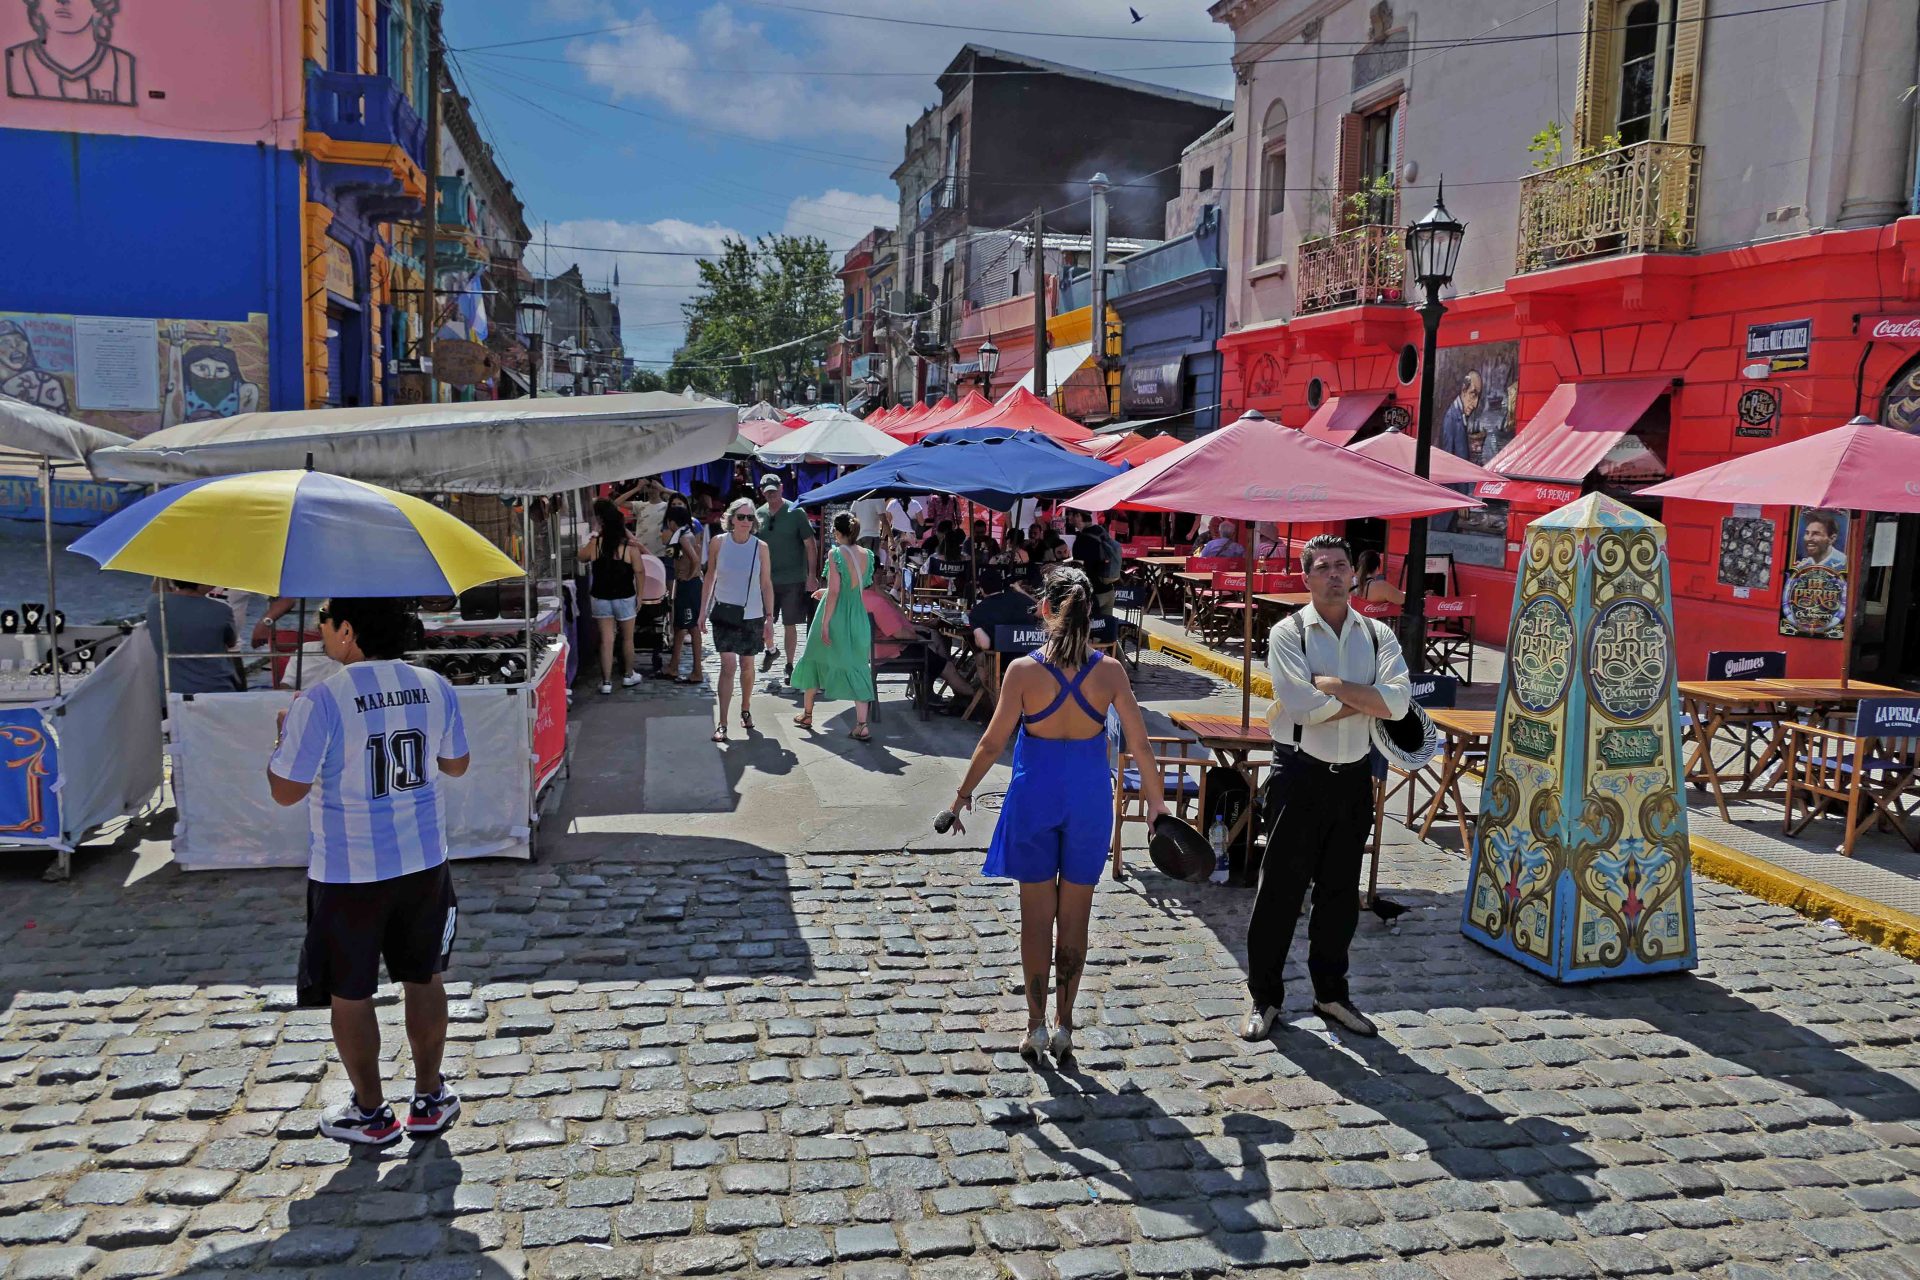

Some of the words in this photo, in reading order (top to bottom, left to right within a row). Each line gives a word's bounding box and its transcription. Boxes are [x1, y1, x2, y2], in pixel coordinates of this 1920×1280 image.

[1013, 631, 1025, 642] LA
[1533, 616, 1557, 638] LA
[1616, 620, 1645, 643] LA
[1513, 634, 1573, 677] PERLA
[1590, 637, 1666, 680] PERLA
[1725, 656, 1765, 678] Quilmes
[1518, 677, 1558, 695] CAMINITO
[1603, 687, 1657, 700] CAMINITO
[354, 688, 430, 713] MARADONA
[1875, 706, 1888, 723] LA
[1513, 719, 1549, 742] Bar
[1602, 730, 1652, 754] Bar
[1609, 745, 1656, 759] notable
[366, 728, 429, 800] 10
